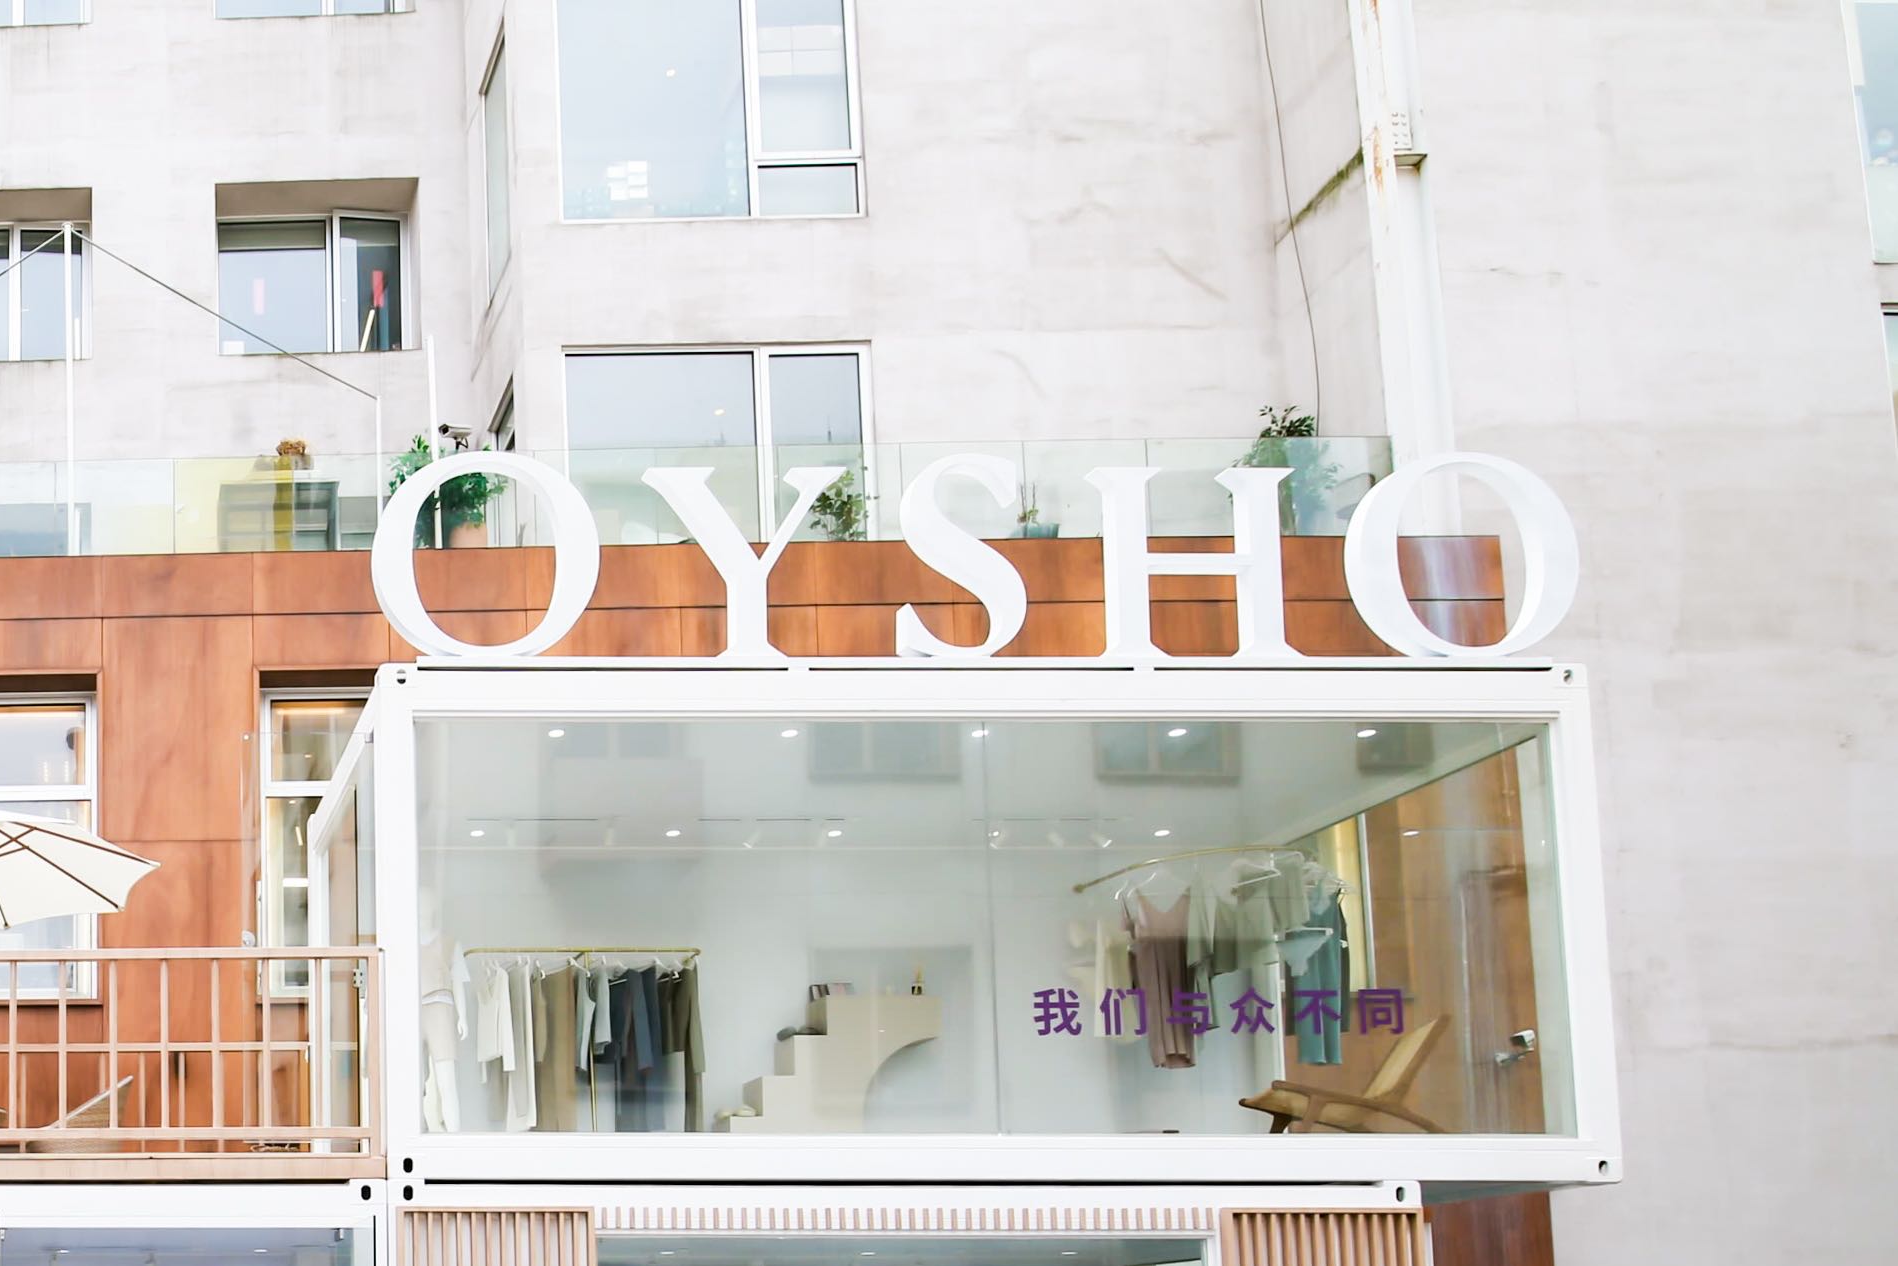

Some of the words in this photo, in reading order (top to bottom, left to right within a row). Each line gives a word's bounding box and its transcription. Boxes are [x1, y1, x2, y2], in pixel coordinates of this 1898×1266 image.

[370, 450, 1579, 658] OYSHO
[1033, 988, 1406, 1036] 我们与众不同
